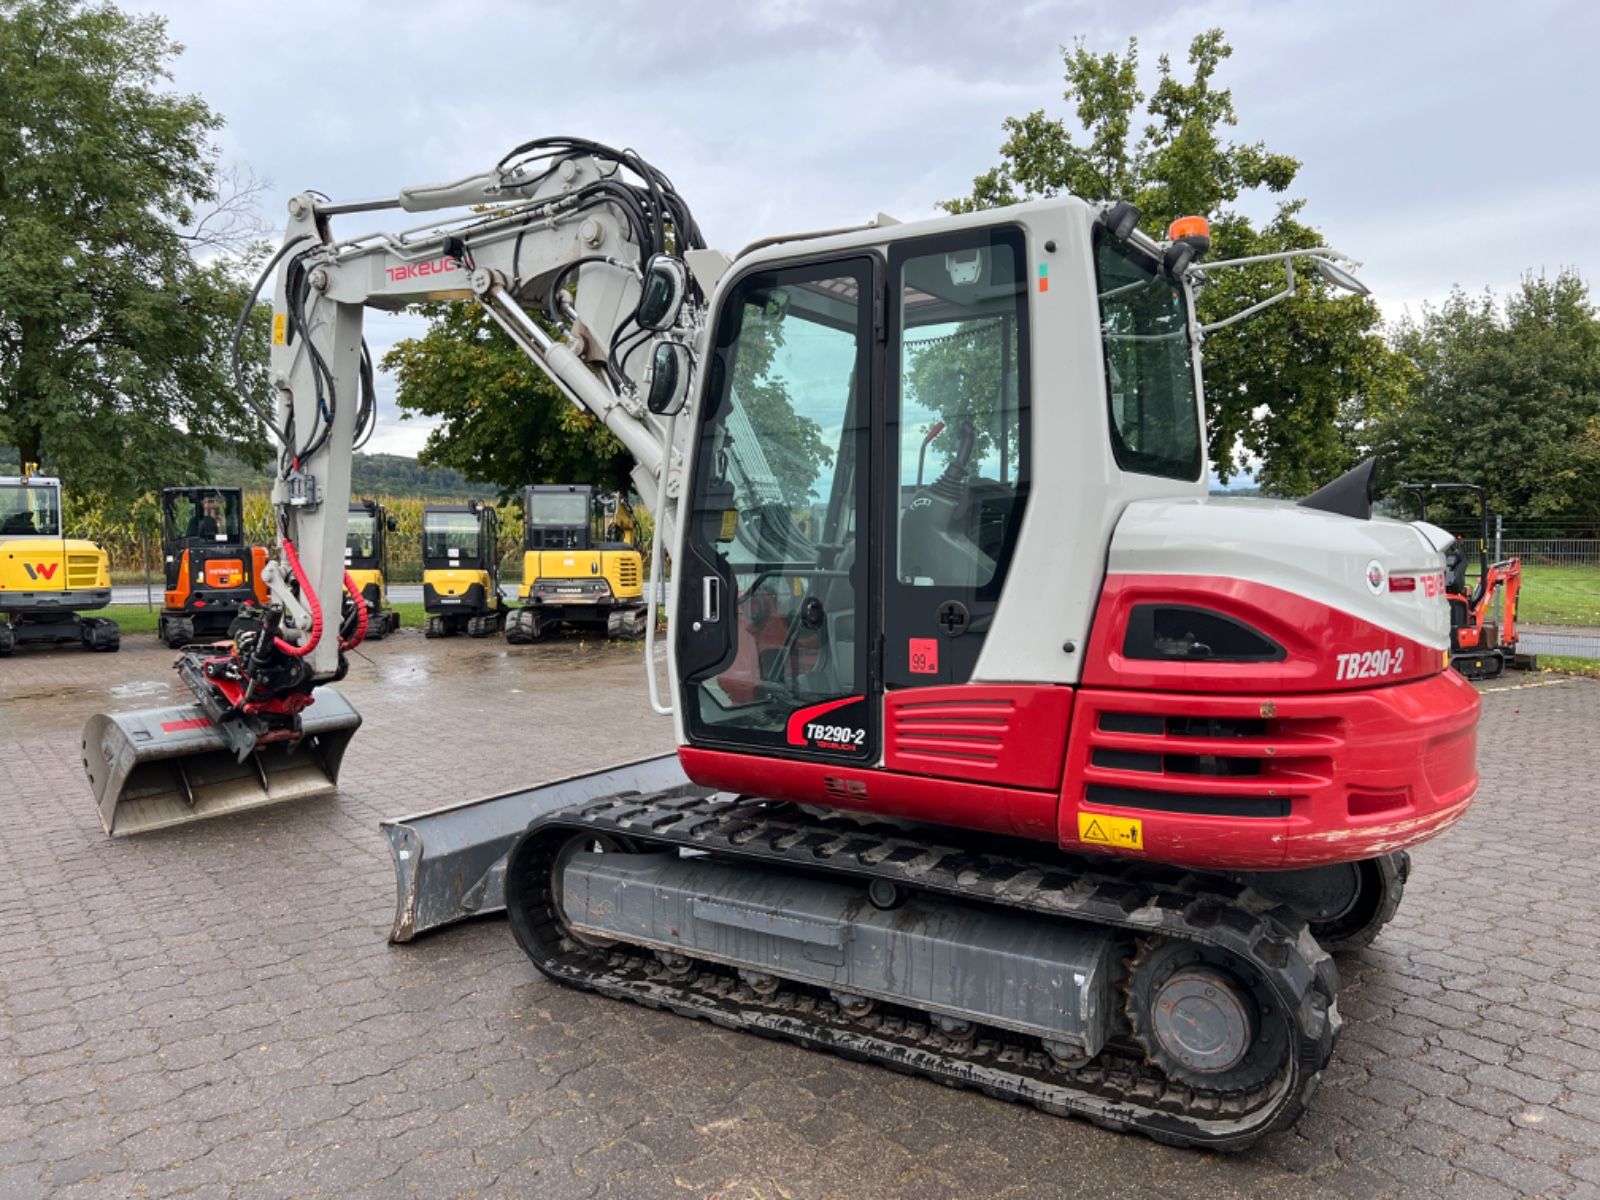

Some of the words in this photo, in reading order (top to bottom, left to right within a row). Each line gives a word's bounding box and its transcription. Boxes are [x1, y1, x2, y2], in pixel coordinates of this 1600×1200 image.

[386, 256, 462, 282] TAKEUC
[912, 653, 926, 670] 99
[1336, 647, 1404, 680] TB290-2
[807, 723, 866, 745] TB290-2
